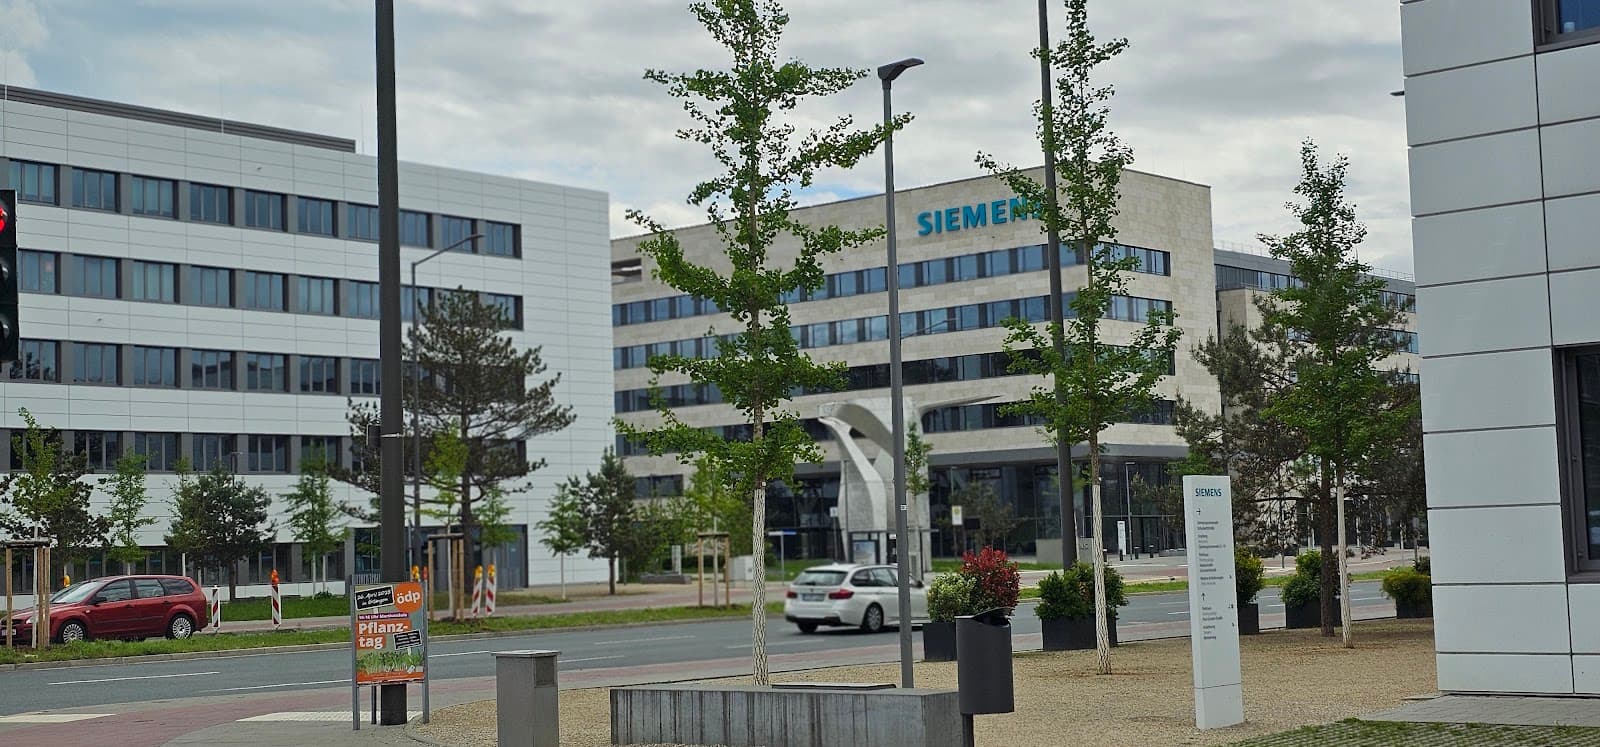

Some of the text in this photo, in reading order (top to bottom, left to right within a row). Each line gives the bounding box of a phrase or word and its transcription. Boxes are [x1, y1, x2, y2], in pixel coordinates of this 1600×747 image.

[1195, 488, 1222, 497] SIEMENS
[397, 590, 421, 604] ödp
[359, 621, 408, 635] Pflanz-
[359, 636, 384, 650] tag
